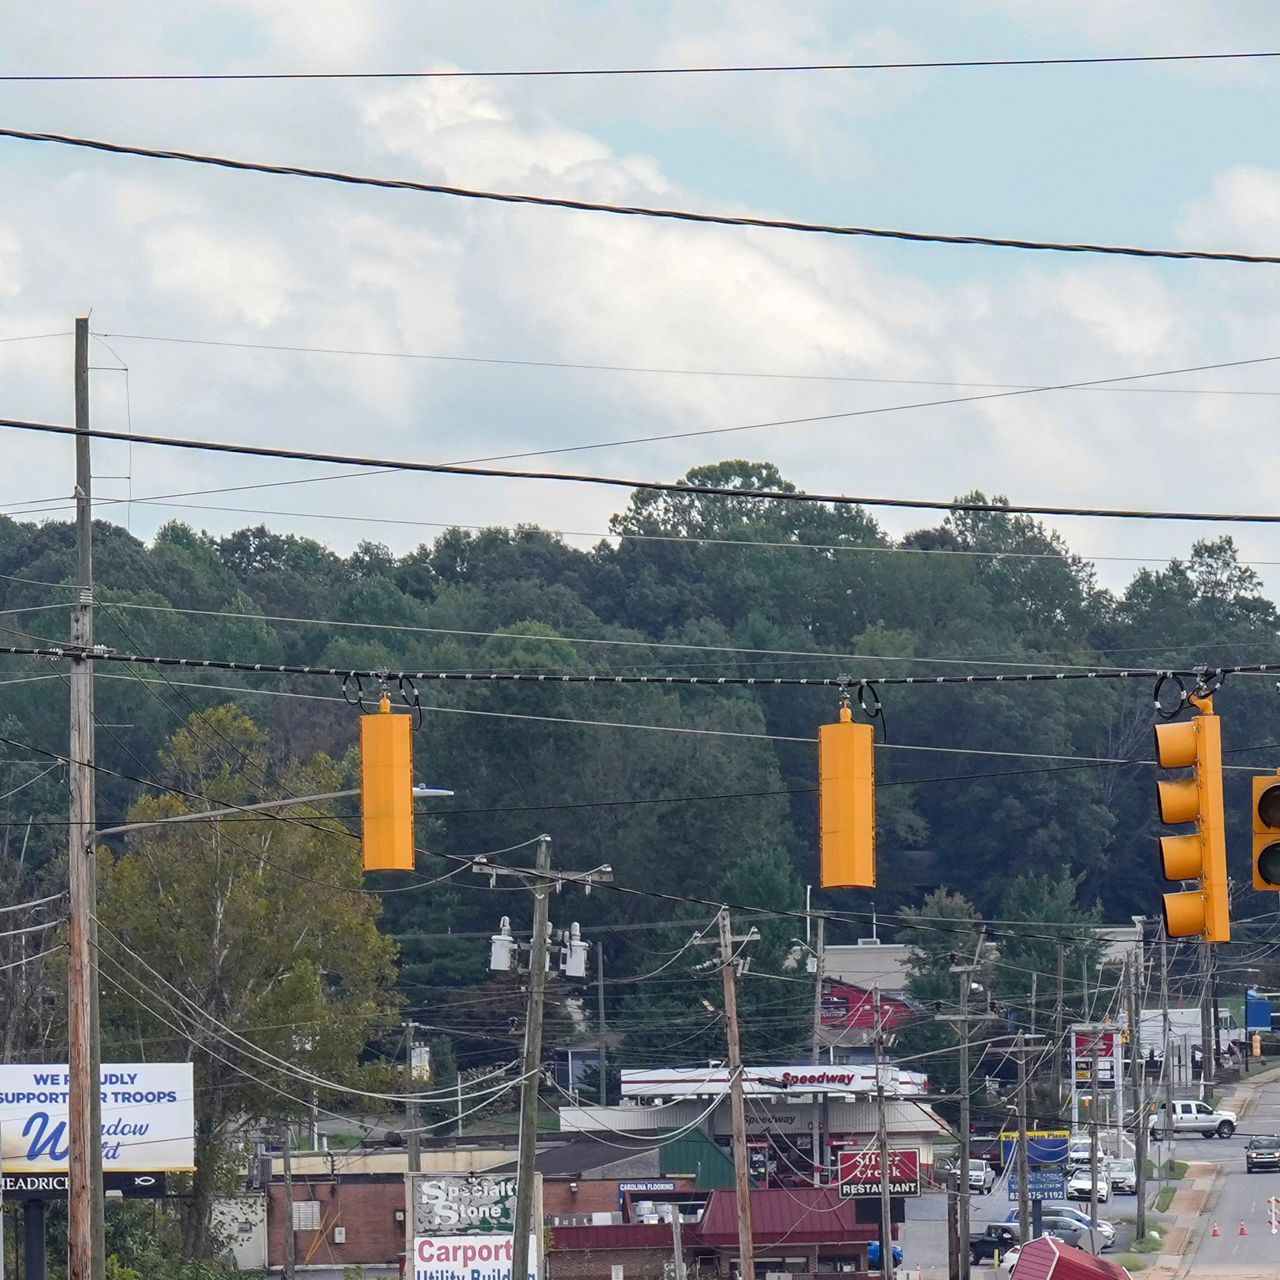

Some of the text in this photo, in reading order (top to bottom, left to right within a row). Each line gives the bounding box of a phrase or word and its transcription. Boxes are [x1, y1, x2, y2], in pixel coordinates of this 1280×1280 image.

[33, 1073, 138, 1085] WE PUDLY
[782, 1072, 855, 1086] Speedway
[111, 1091, 177, 1103] TROOPS
[744, 1114, 796, 1125] Speedway
[619, 1183, 674, 1191] CAROLINA FLOORING
[434, 1200, 502, 1225] Stone
